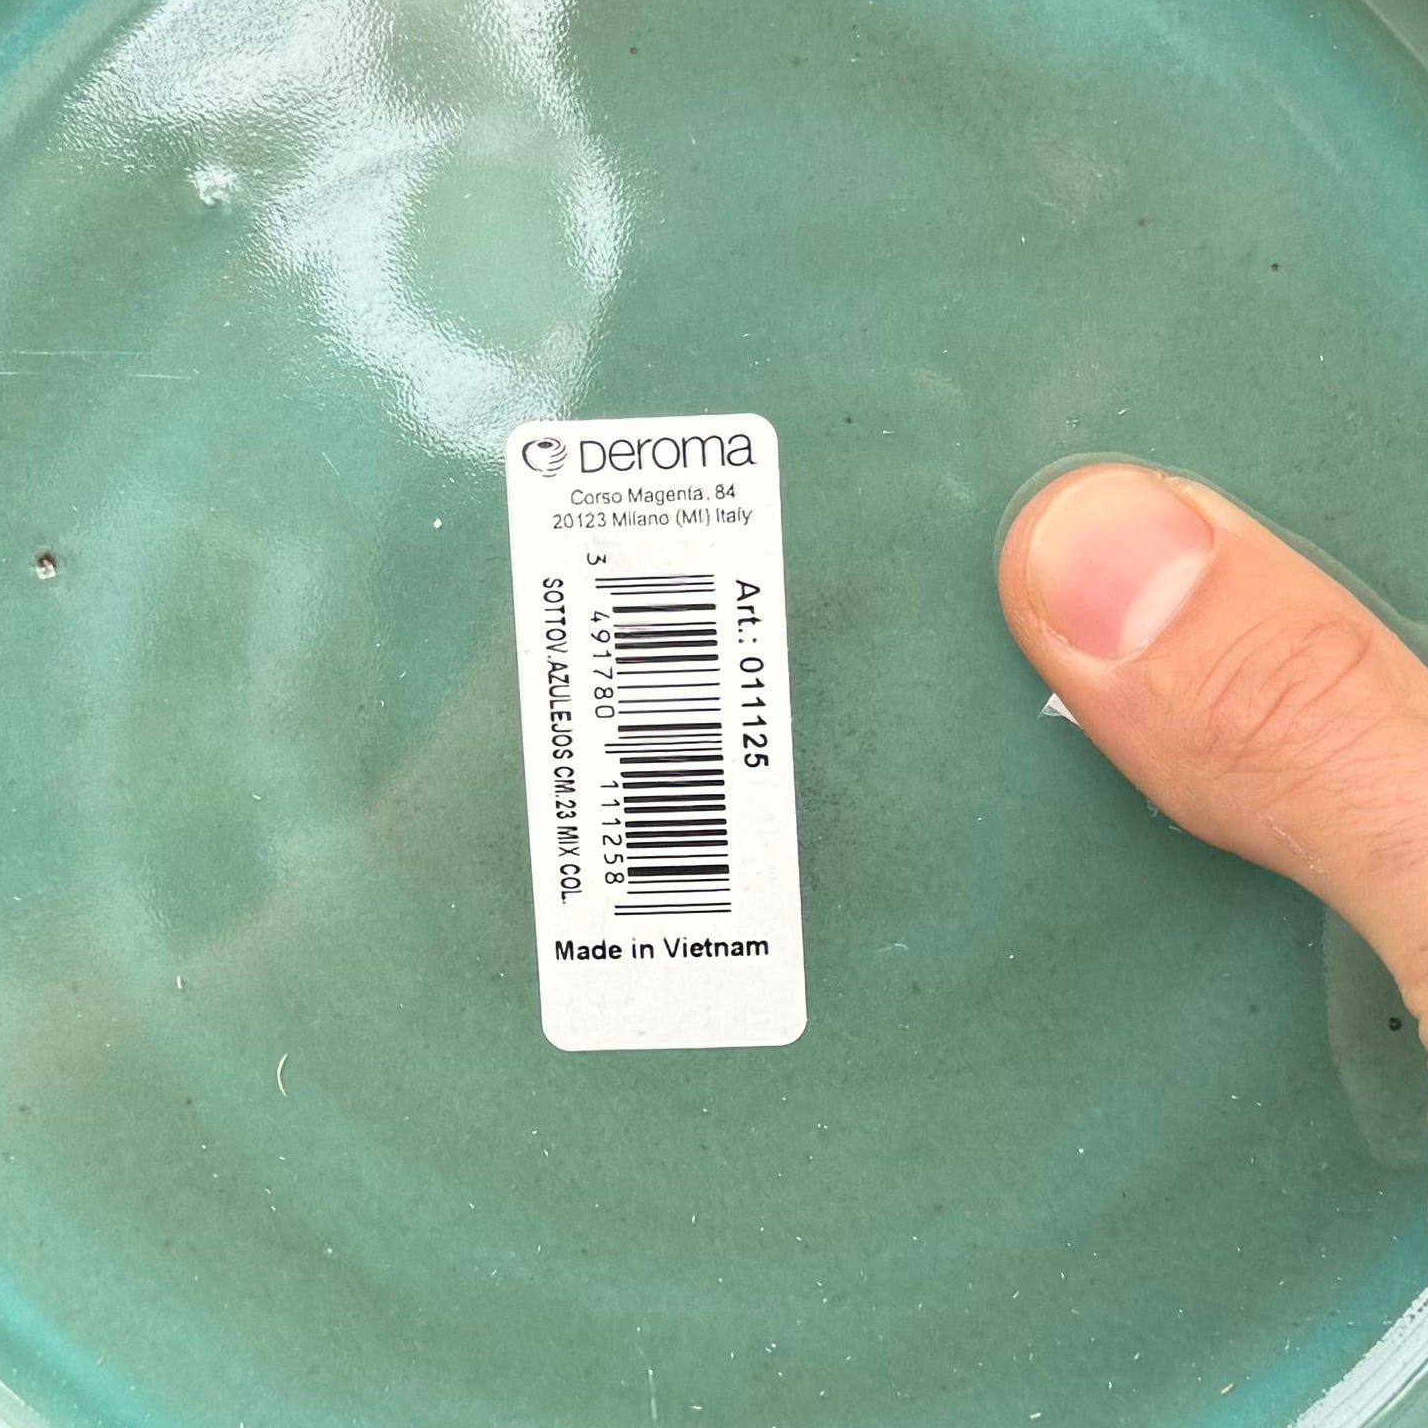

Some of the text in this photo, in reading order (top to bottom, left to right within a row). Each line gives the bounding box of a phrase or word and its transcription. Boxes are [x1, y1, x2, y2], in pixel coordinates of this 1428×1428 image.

[579, 433, 758, 474] Deroma
[570, 488, 623, 506] Corso
[714, 483, 736, 501] 84
[552, 505, 753, 530] 20123 Milano (MI) Italy
[542, 577, 574, 760] SOTTOV.AZULEJOS
[735, 579, 770, 768] Art.: 011125
[586, 552, 625, 885] 3 491780 111258
[553, 766, 577, 820] CM.23
[556, 826, 581, 858] MIX
[555, 936, 770, 961] Made in Vietnam
